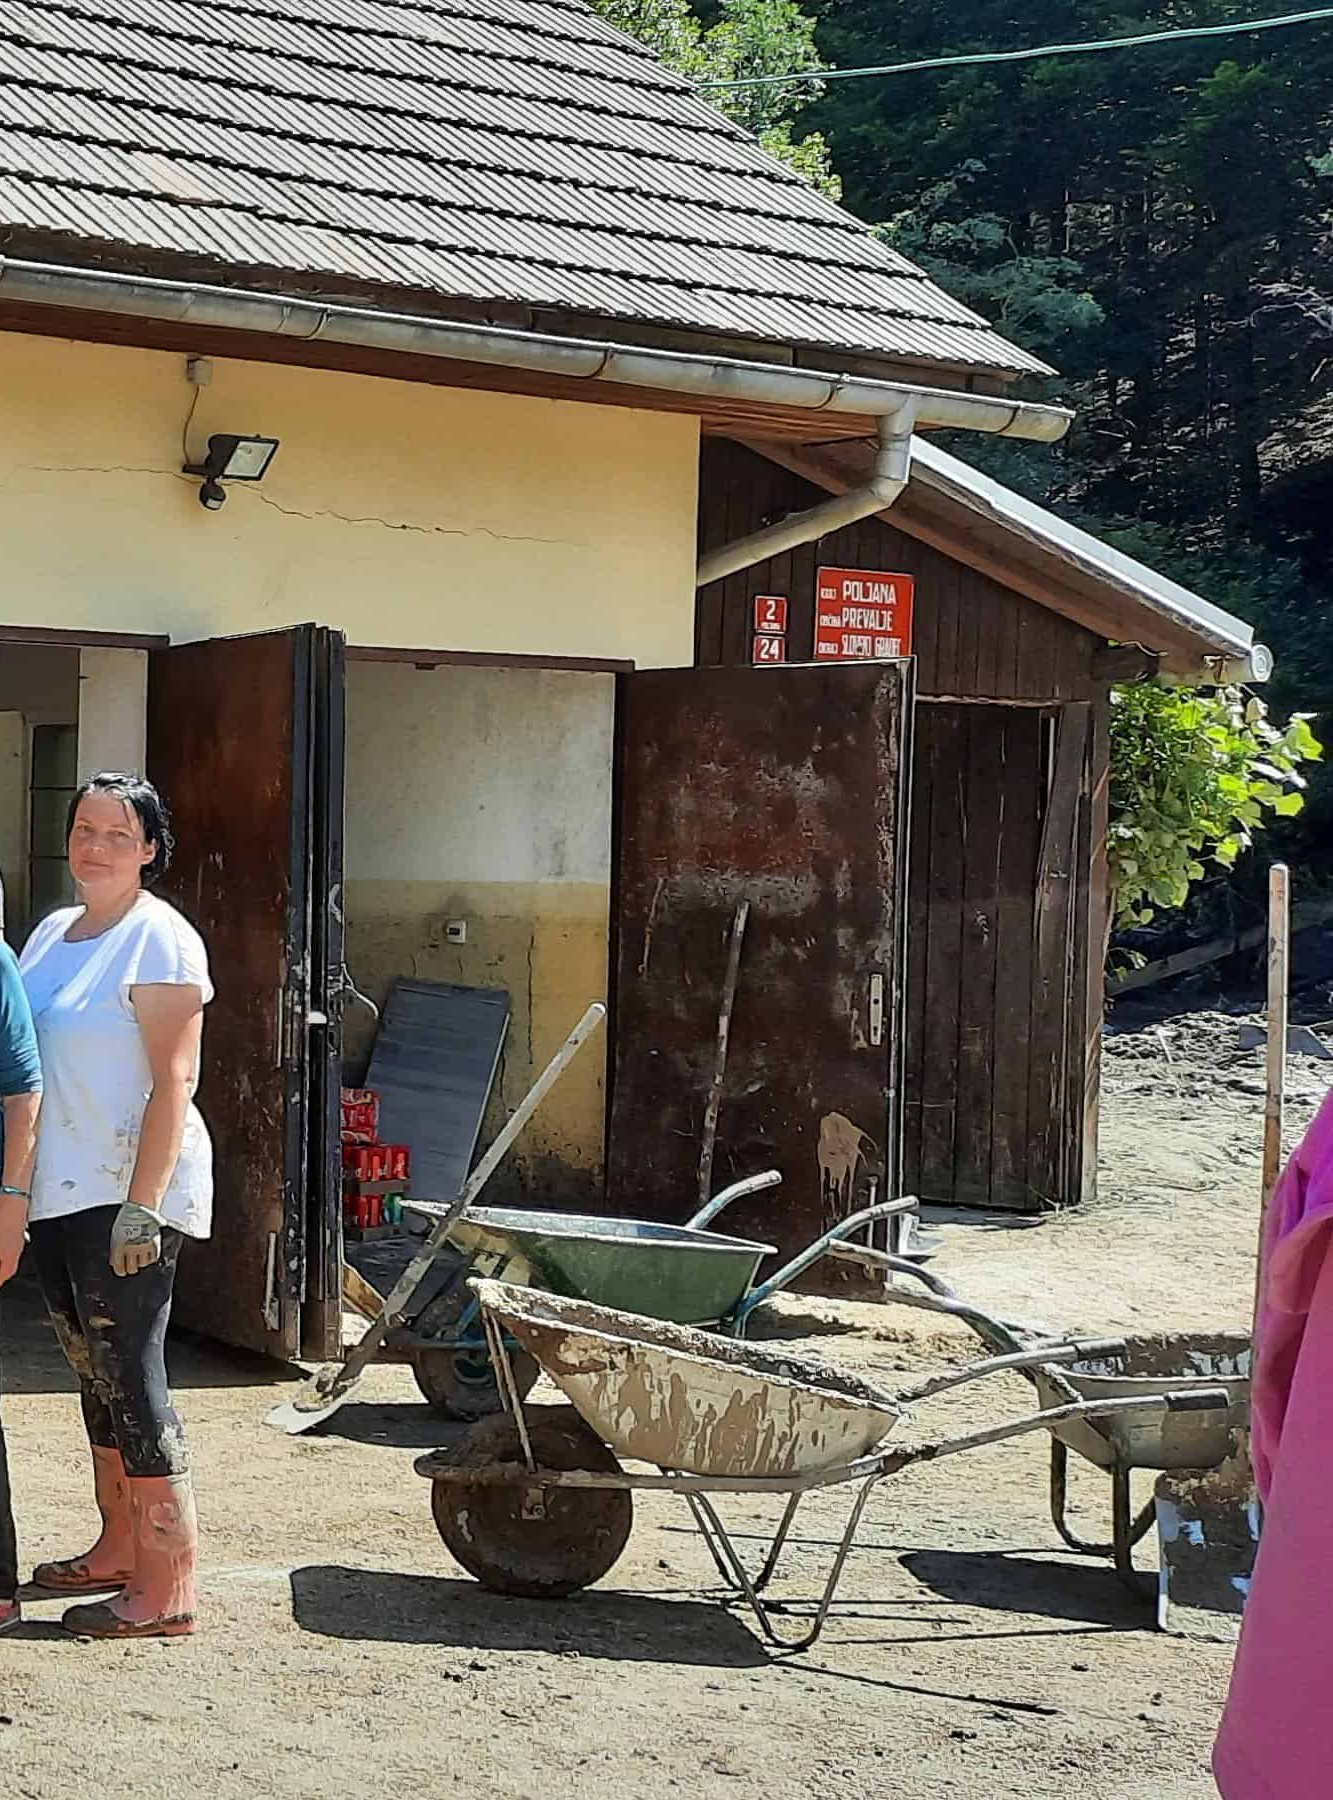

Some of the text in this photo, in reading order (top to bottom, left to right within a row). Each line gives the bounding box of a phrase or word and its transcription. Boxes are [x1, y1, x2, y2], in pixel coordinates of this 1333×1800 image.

[843, 580, 896, 605] POLJANA
[766, 600, 775, 620] 2
[841, 607, 893, 631] PREVALJE
[760, 639, 779, 660] 24
